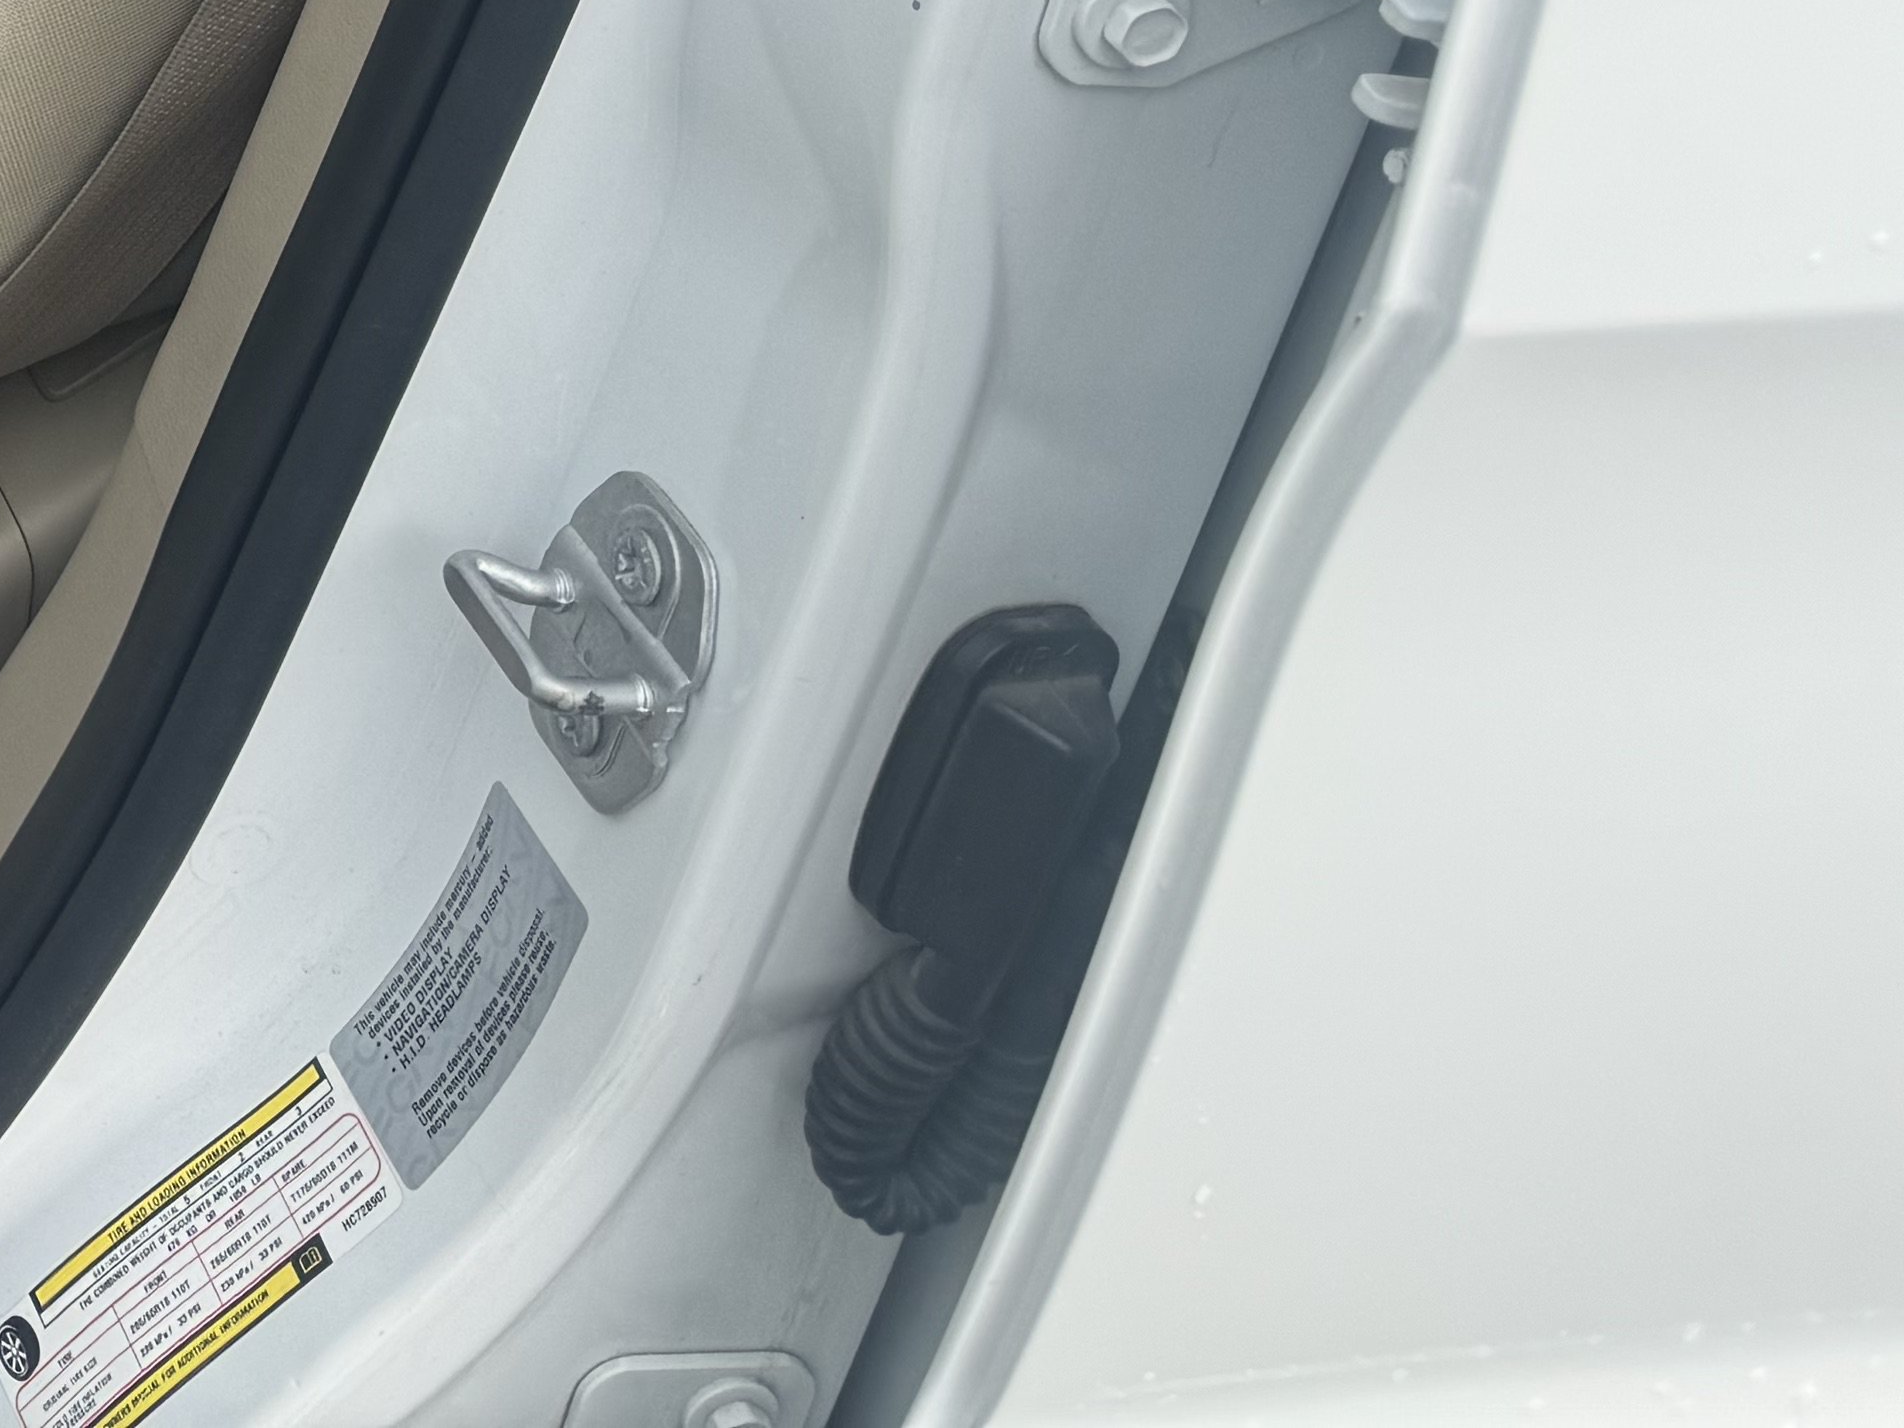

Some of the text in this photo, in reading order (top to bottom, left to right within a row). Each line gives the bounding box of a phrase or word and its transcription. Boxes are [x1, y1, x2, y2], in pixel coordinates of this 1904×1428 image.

[480, 863, 511, 925] DISPLAY
[353, 1010, 375, 1036] This
[383, 946, 453, 1042] VIDEO DISPLAY
[428, 951, 482, 1033] HEADLAMPS
[107, 1220, 129, 1244] TIRE
